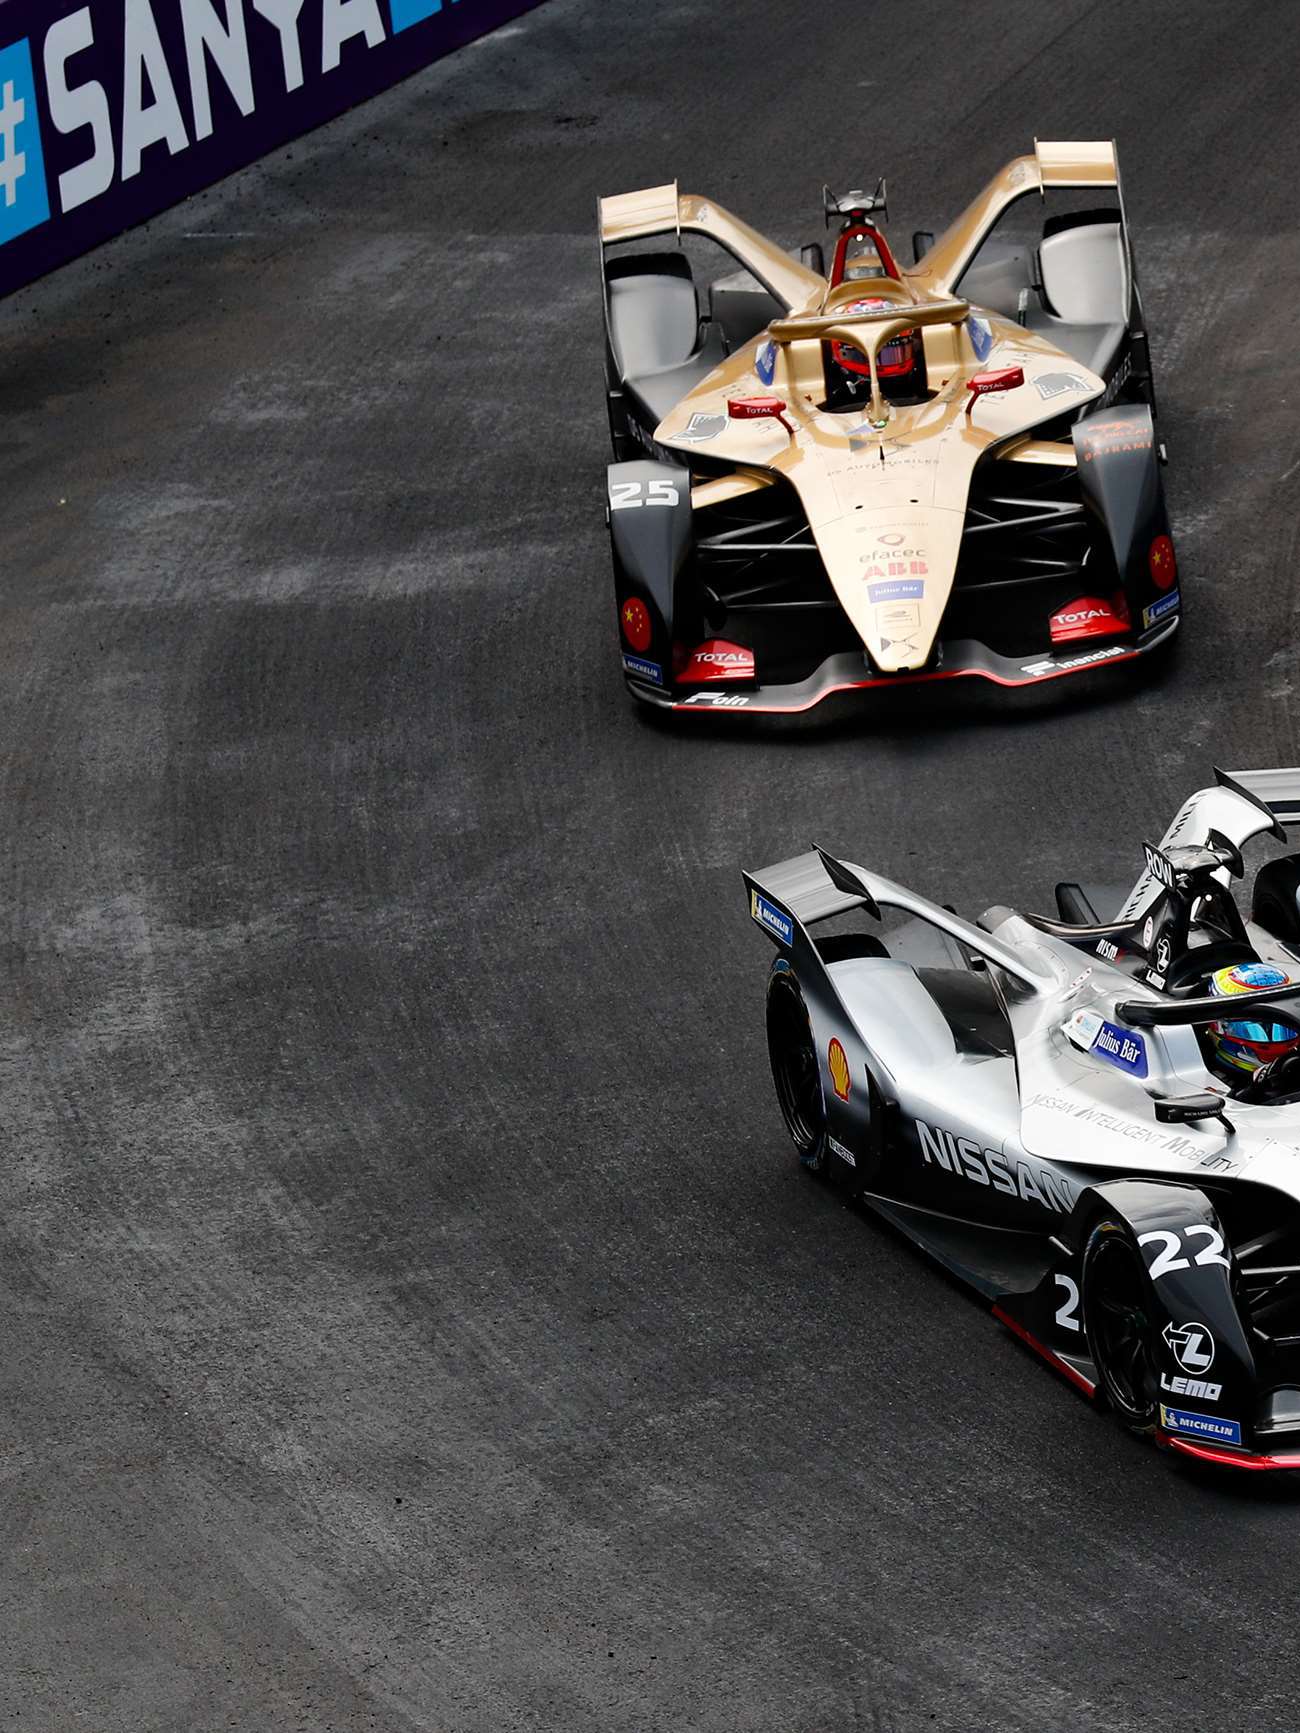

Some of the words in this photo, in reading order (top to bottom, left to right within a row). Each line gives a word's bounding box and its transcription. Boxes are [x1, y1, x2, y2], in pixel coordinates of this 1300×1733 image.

[746, 406, 773, 414] TOTAL
[610, 479, 679, 511] 25
[859, 548, 927, 562] efacec
[862, 560, 929, 581] ABB
[1053, 608, 1111, 624] TOTAL
[627, 660, 659, 677] MICHELIN
[695, 652, 749, 662] TOTAL
[1020, 646, 1126, 676] Financial
[1145, 846, 1174, 889] ROW
[763, 908, 790, 936] MICHELIN
[1092, 1027, 1121, 1054] Julius
[1120, 1038, 1141, 1063] Bär
[914, 1118, 1075, 1215] NISSAN
[1160, 1136, 1239, 1173] MOBILITY
[1137, 1224, 1231, 1281] 22
[1160, 1372, 1223, 1401] LEMO
[1179, 1418, 1233, 1437] MICHELIN
